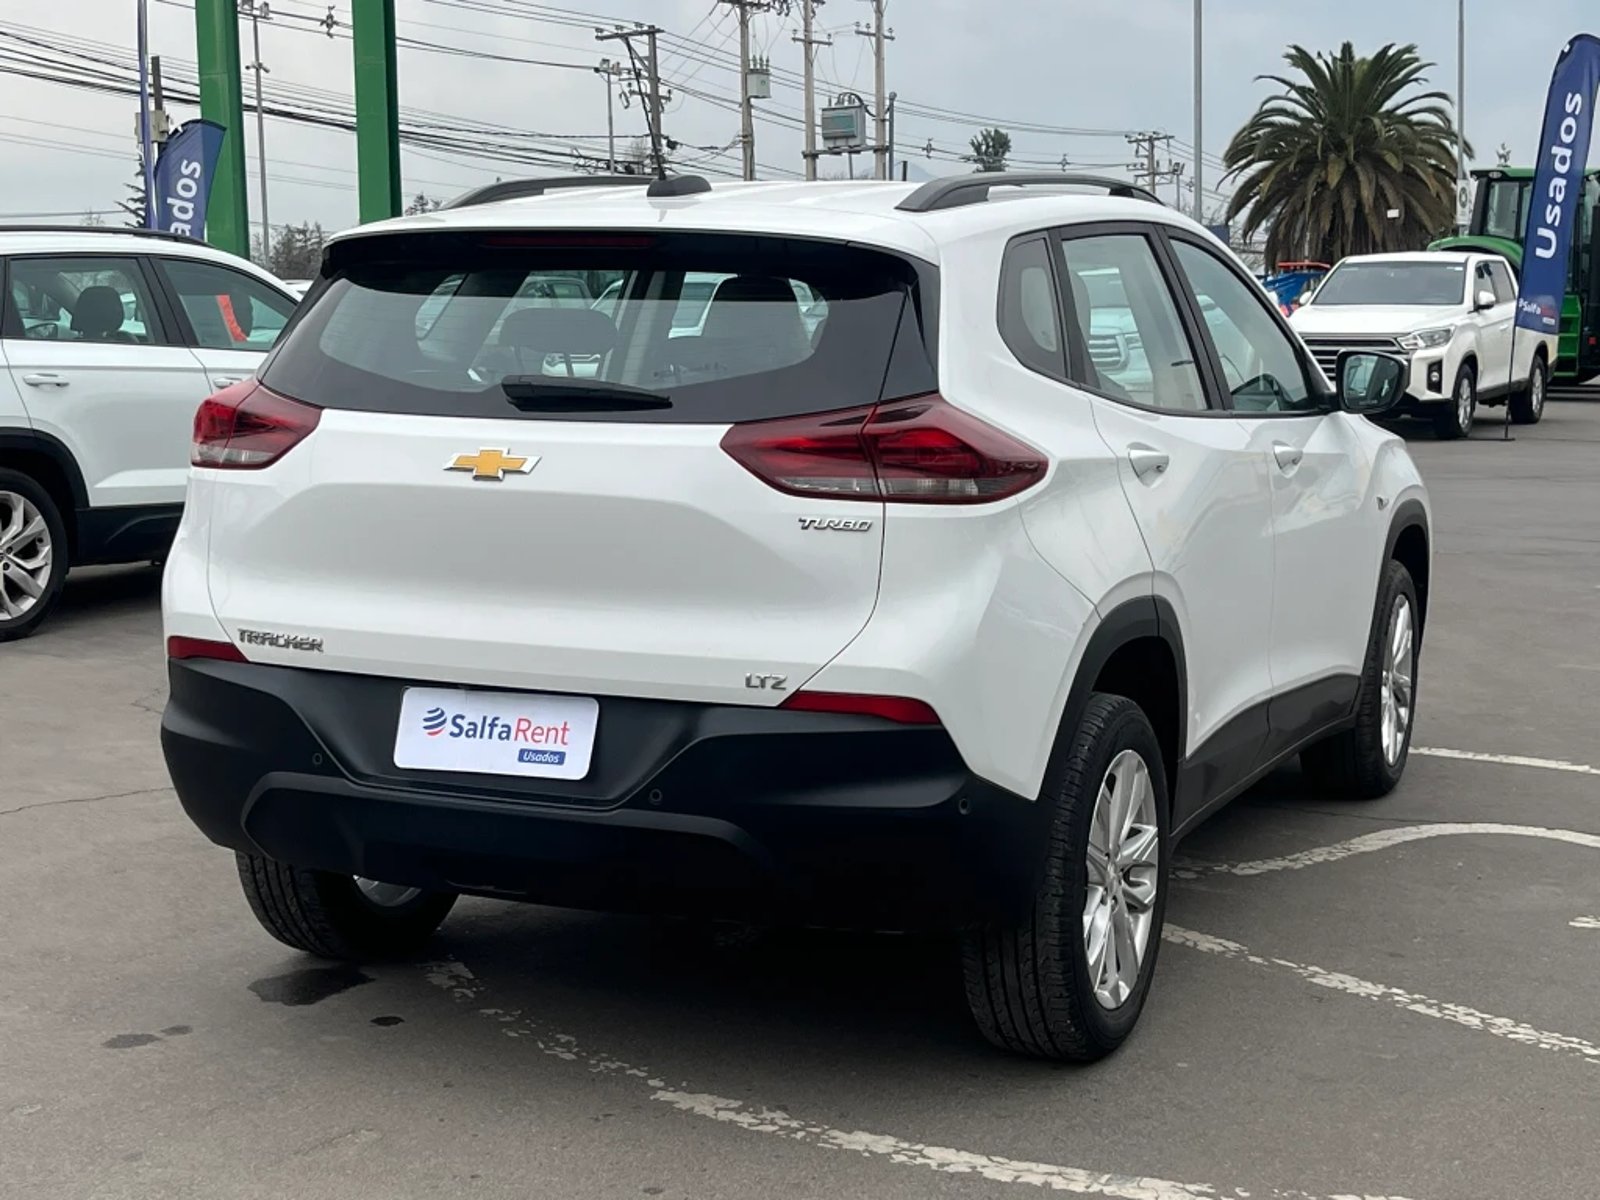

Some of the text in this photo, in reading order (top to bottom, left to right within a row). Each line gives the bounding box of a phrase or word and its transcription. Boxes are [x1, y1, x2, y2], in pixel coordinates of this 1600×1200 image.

[1535, 92, 1582, 260] Usados
[798, 517, 872, 532] TURBO
[237, 628, 324, 653] TRACKER
[745, 672, 787, 690] LTZ
[522, 750, 561, 764] Usados
